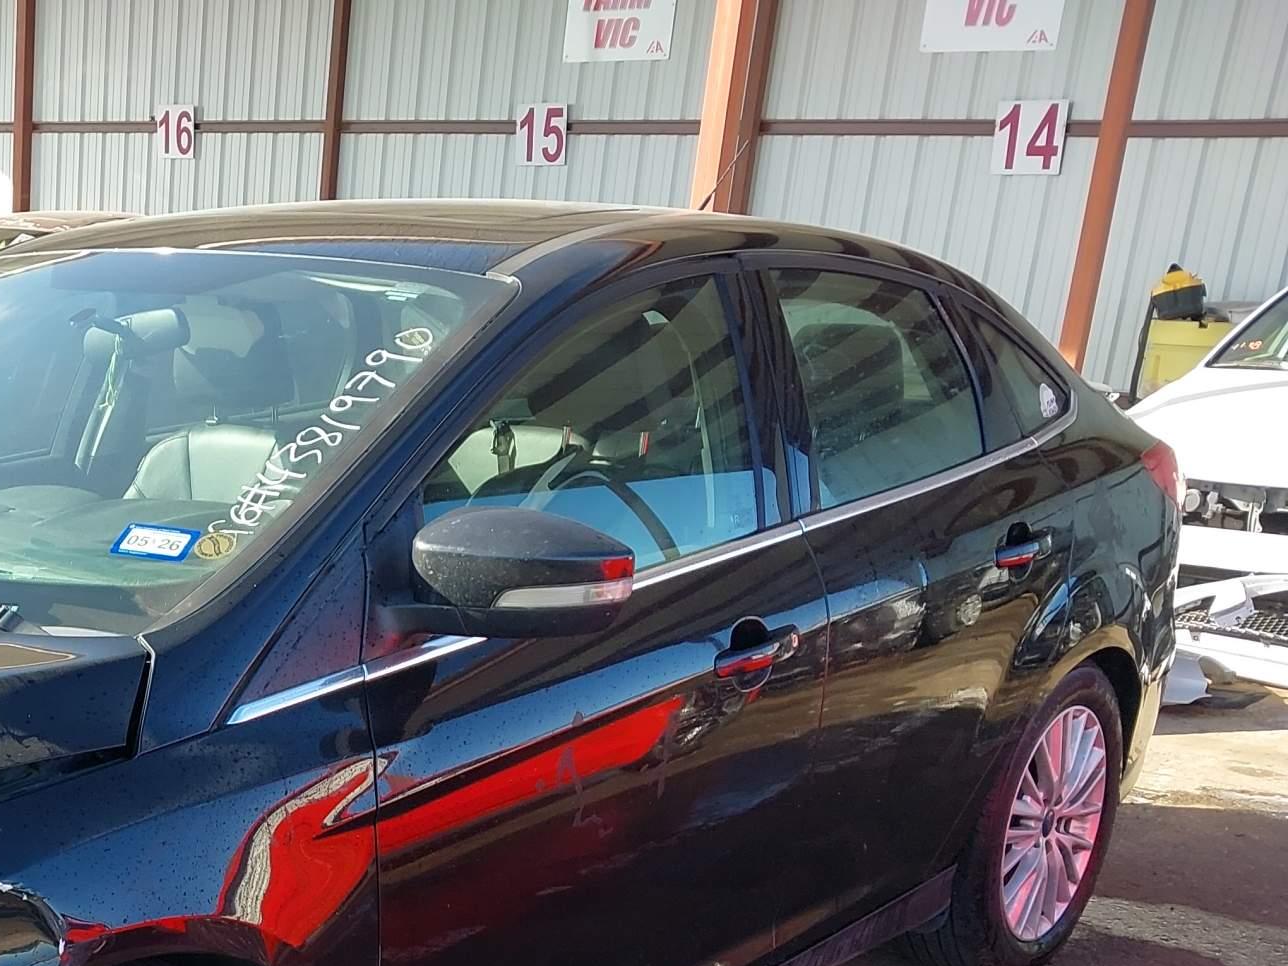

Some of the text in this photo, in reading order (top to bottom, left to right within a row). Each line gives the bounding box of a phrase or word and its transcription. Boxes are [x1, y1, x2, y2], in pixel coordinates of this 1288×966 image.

[594, 17, 641, 49] VIC
[158, 110, 193, 156] 16
[519, 107, 564, 163] 15
[999, 103, 1059, 170] 14
[126, 534, 150, 547] 05
[157, 538, 184, 552] 26
